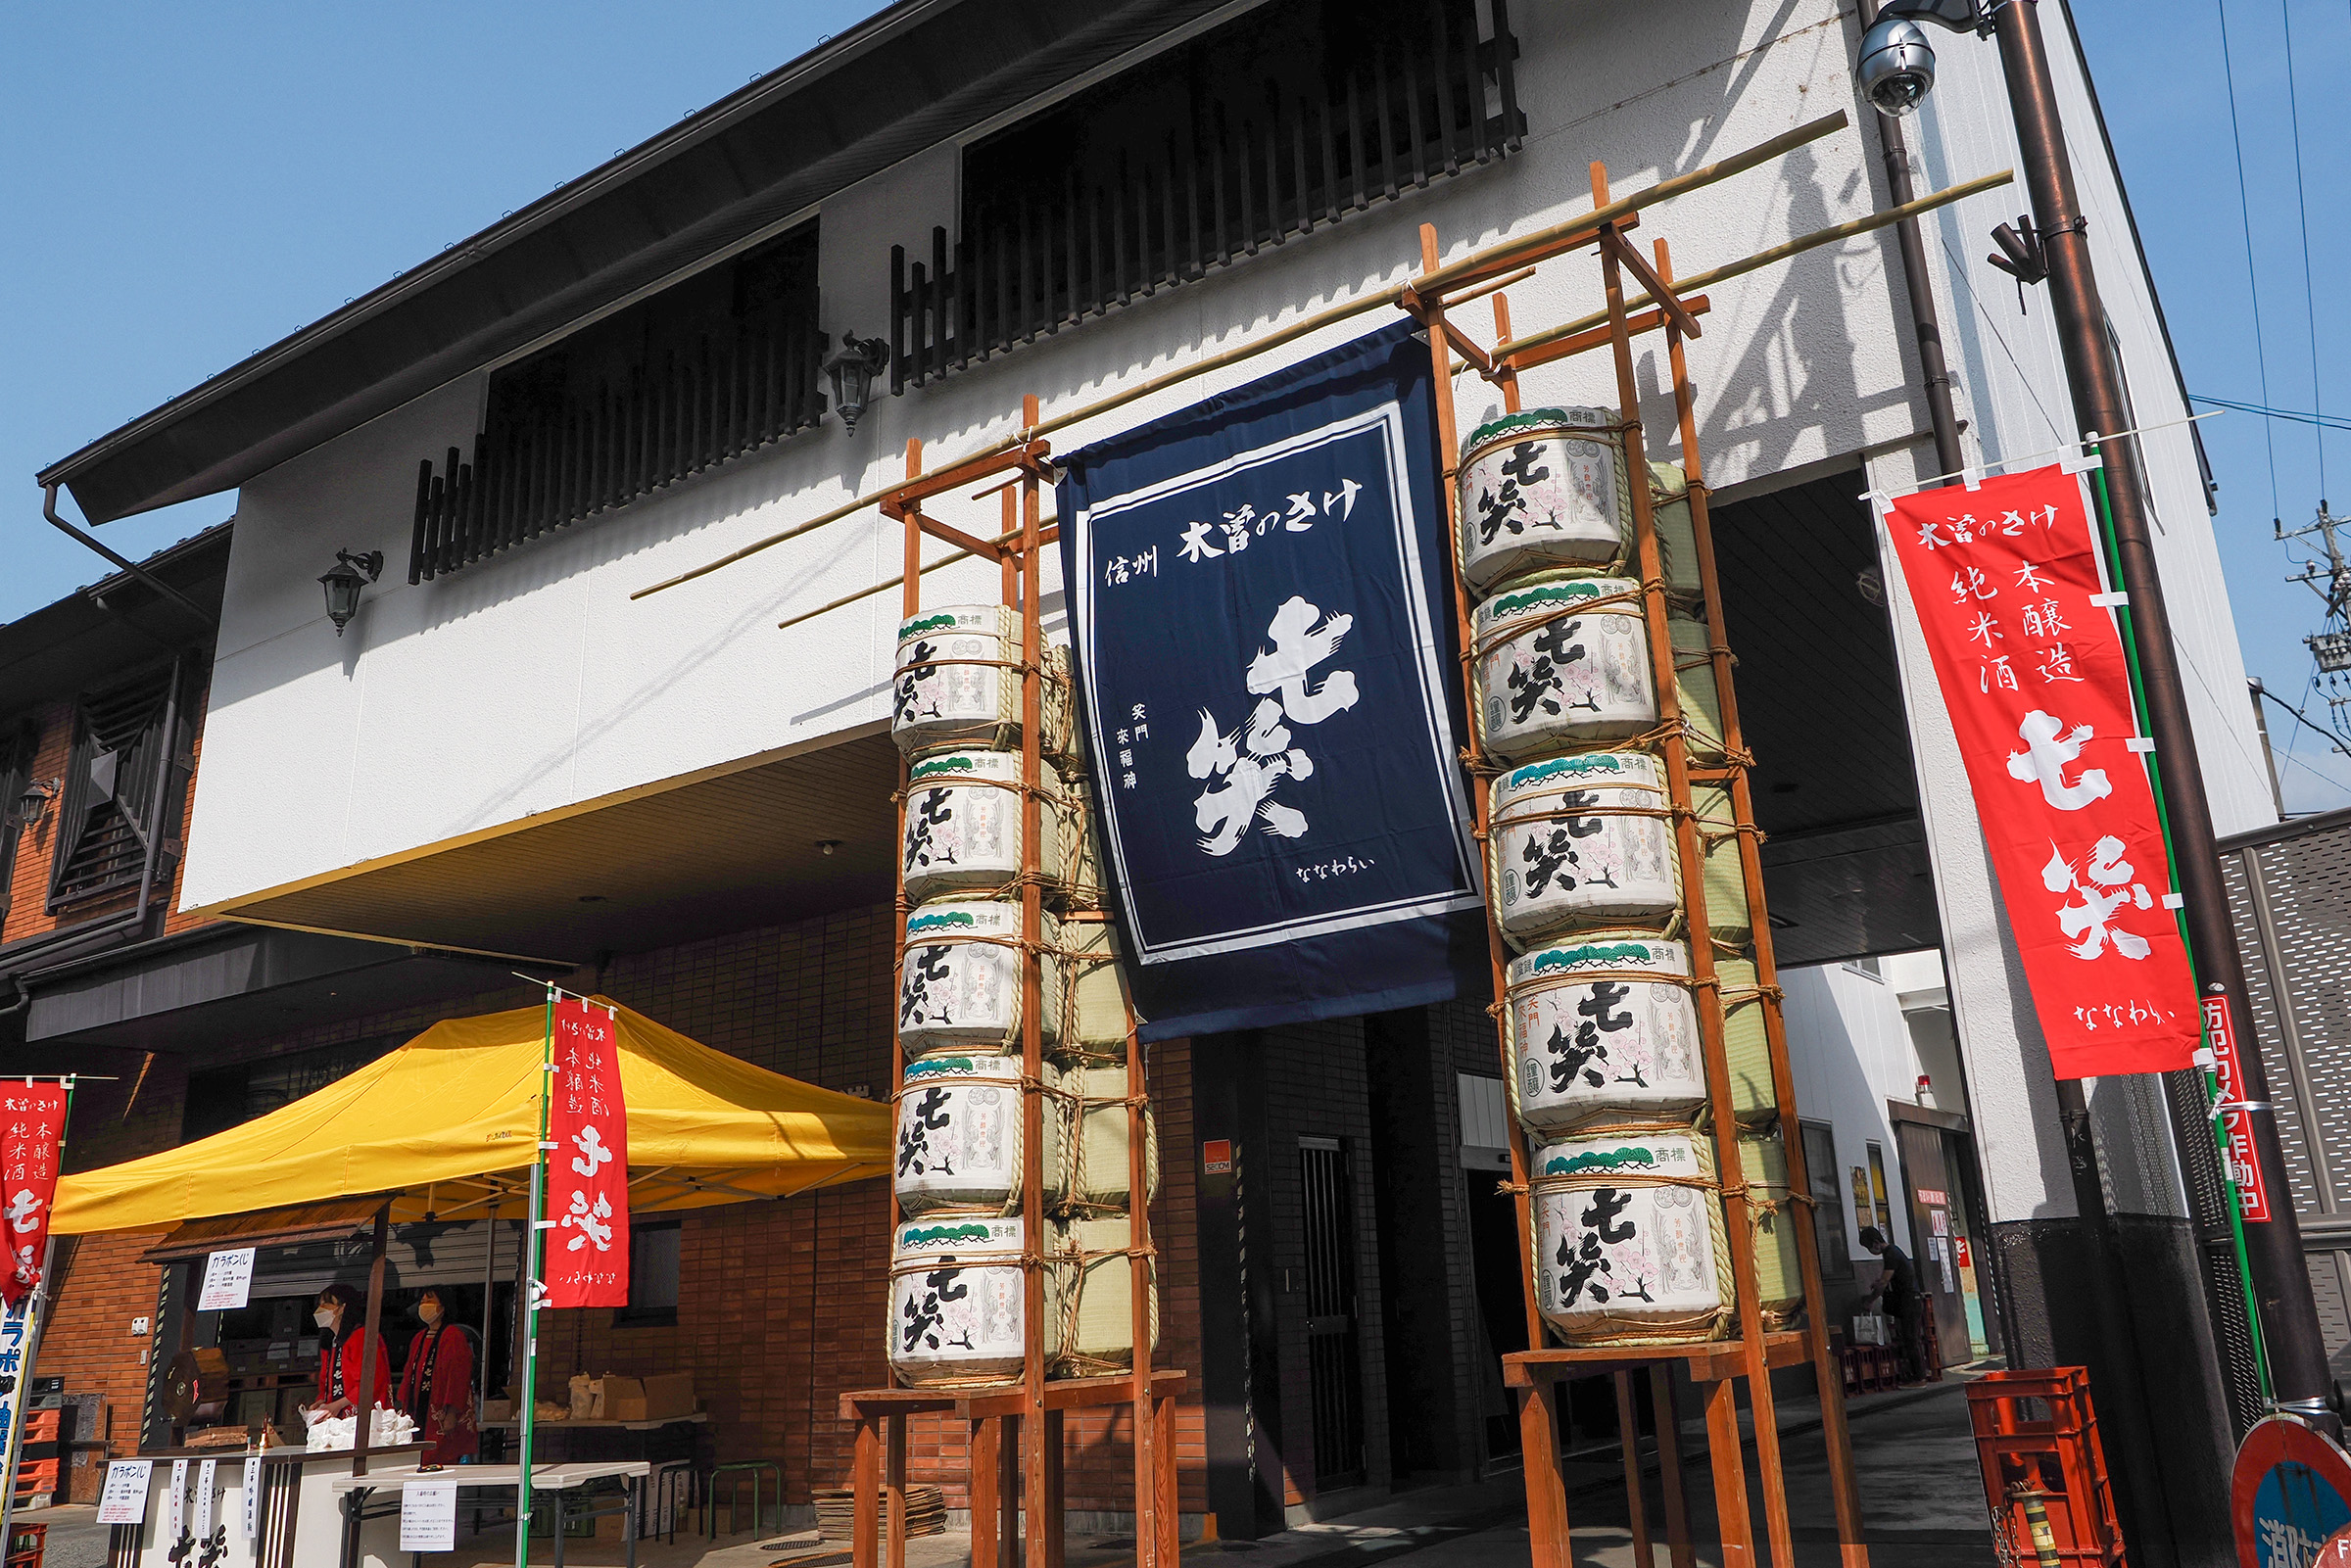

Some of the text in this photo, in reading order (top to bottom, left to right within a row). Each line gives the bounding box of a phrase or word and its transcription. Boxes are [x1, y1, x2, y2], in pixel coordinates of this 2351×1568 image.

[1569, 411, 1596, 424] 商標
[1477, 441, 1550, 546] 七笑
[1105, 478, 1363, 588] 信州 木曽のさけ
[1917, 503, 2058, 550] 木曽のさけ
[957, 614, 983, 626] 商標
[1950, 566, 2018, 694] 純米酒
[2013, 560, 2085, 684] 本醸造
[1508, 617, 1586, 725] 七笑
[1131, 702, 1149, 741] 笑門
[1185, 595, 1360, 857] 七笑
[974, 757, 999, 769] 商標
[1620, 757, 1648, 771] 商標
[906, 787, 953, 873] 七笑
[1522, 789, 1604, 899] 七笑
[2006, 709, 2153, 960] 七笑
[1295, 856, 1375, 883] ななわらい
[976, 914, 1001, 927] 商標
[1652, 946, 1676, 963] 商標
[900, 945, 953, 1028] 七笑
[975, 1059, 1001, 1071] 商標
[1547, 981, 1633, 1094] 七笑
[3, 1121, 30, 1181] 純米酒
[32, 1121, 53, 1181] 本醸造
[898, 1087, 952, 1178] 七笑
[1655, 1147, 1686, 1163] 商標
[1206, 1162, 1230, 1171] SECOM
[991, 1224, 1017, 1238] 商標
[1556, 1188, 1636, 1308] 七笑
[903, 1255, 968, 1354] 七笑
